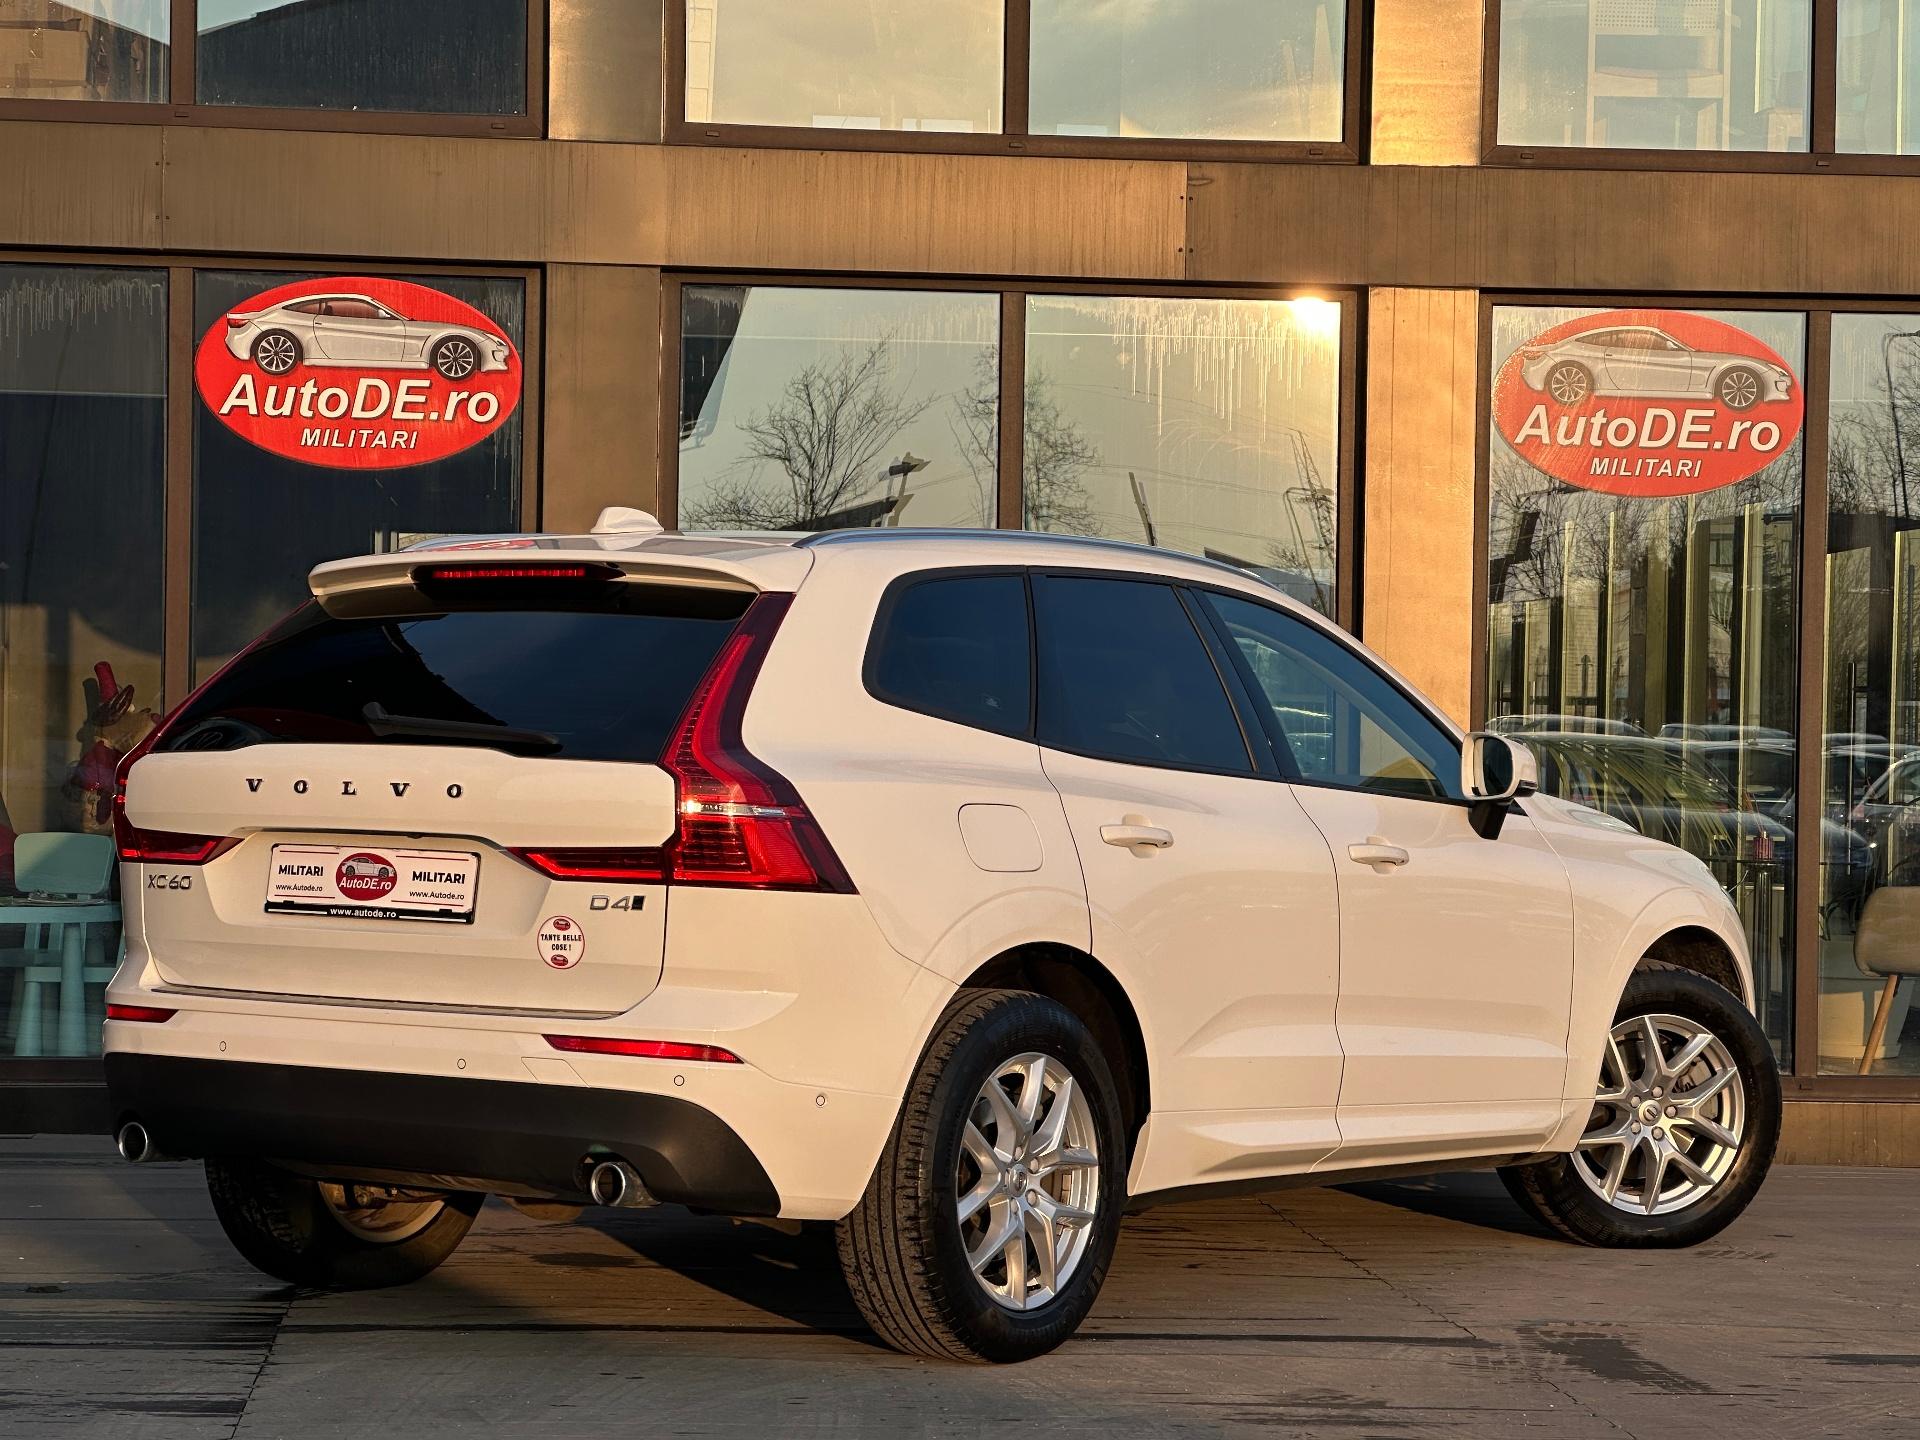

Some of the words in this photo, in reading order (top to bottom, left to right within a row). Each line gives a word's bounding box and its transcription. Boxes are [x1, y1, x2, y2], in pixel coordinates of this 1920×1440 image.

[218, 373, 501, 424] AutoDE.ro
[1513, 403, 1782, 452] AutoDE.ro
[300, 428, 418, 450] MILITARI
[1589, 457, 1703, 478] MILITARI
[245, 777, 463, 799] VOLVO
[277, 864, 324, 877] MILITARI
[411, 870, 466, 885] MILITARI
[147, 873, 193, 890] XC60
[275, 883, 323, 892] www.Autode.ro
[338, 876, 392, 891] AutoDE.ro
[408, 890, 465, 900] www.Autode.ro
[589, 894, 631, 912] D4
[329, 907, 397, 919] www.autode.ro
[540, 933, 561, 941] TANTE
[562, 934, 582, 942] BELLE
[551, 943, 567, 951] COSE
